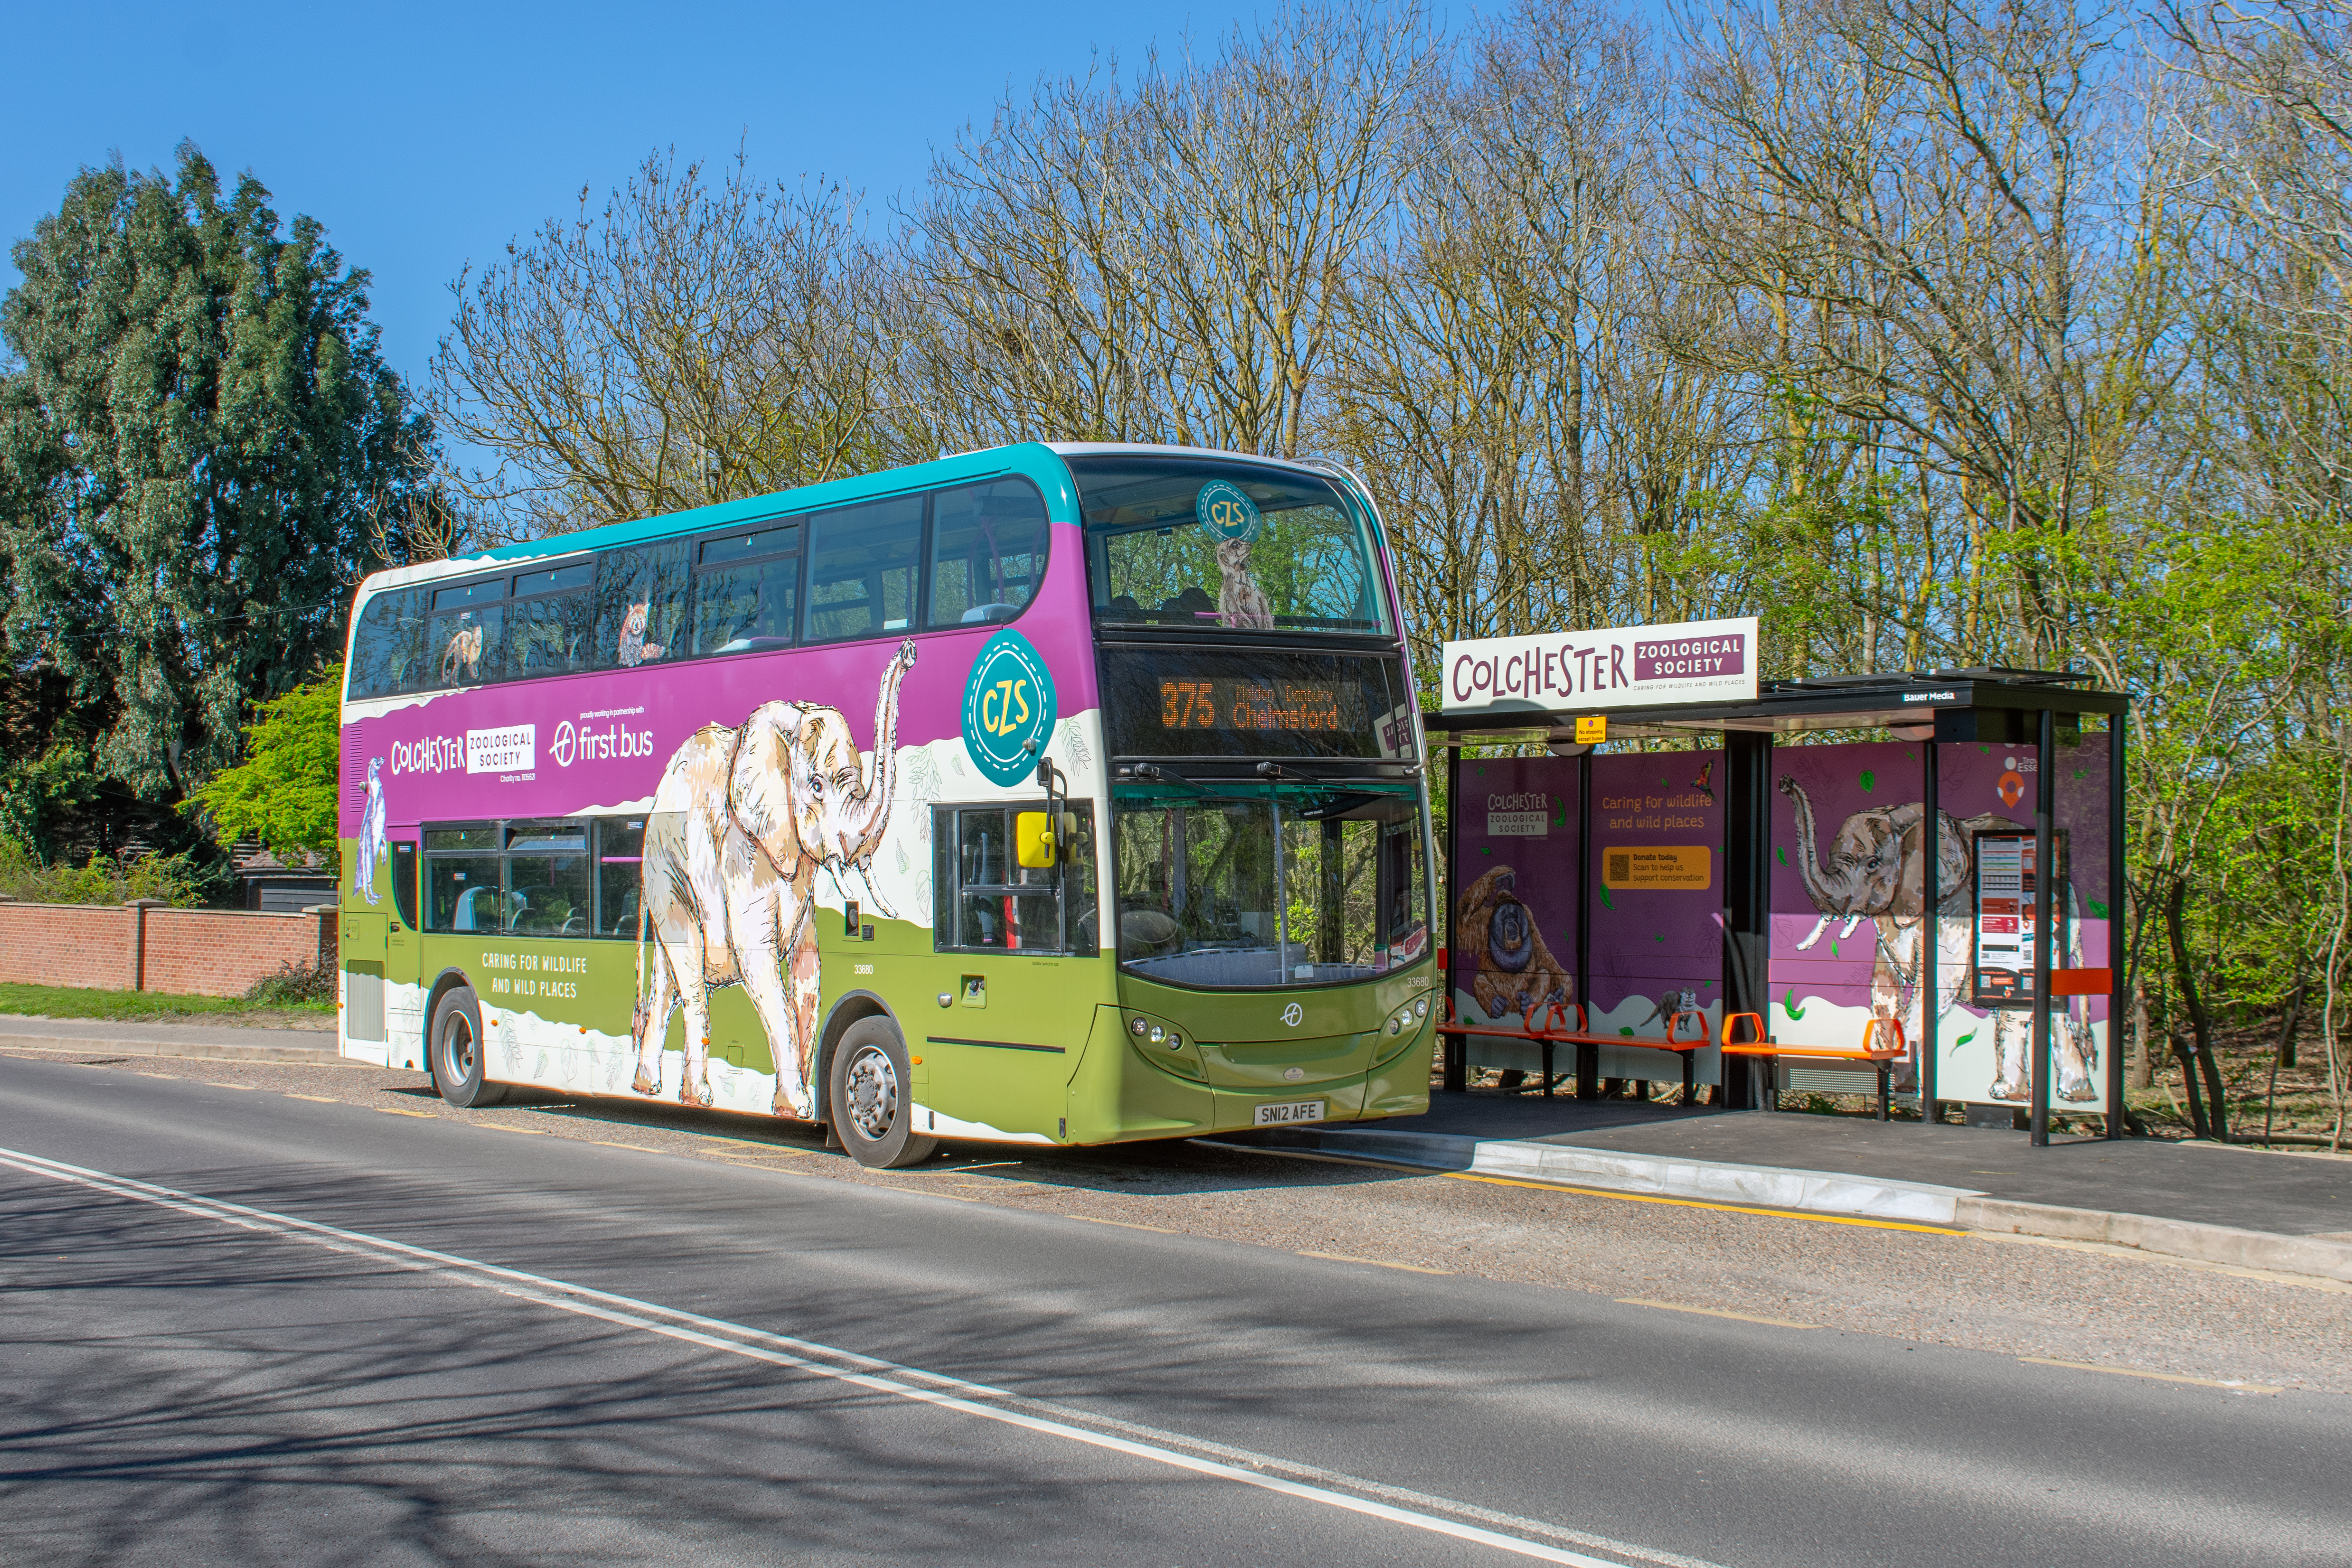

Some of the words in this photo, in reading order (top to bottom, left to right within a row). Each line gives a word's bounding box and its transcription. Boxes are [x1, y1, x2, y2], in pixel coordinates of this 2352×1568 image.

[1211, 501, 1244, 527] CZS
[1638, 639, 1740, 659] ZOOLOGICAL
[1453, 644, 1628, 702] COLCHESTER
[1654, 657, 1723, 675] SOCIETY
[1161, 682, 1214, 727] 375
[1929, 691, 1955, 700] Media
[580, 711, 594, 720] proudly
[594, 709, 609, 718] working
[613, 706, 636, 717] partnership
[983, 680, 1029, 737] CZS
[1234, 703, 1337, 729] Chelmsford
[470, 732, 531, 750] ZOOLOGICAL
[579, 724, 617, 760] first
[620, 723, 653, 757] bus
[391, 735, 465, 775] COLCHESTER
[480, 751, 521, 766] SOCIETY
[500, 775, 514, 784] Charity
[1488, 792, 1548, 810] COLCHESTER
[1603, 797, 1642, 812] Caring
[1646, 796, 1663, 808] for
[1667, 794, 1712, 807] wildlife
[1610, 816, 1633, 828] and
[1637, 816, 1661, 828] wild
[1665, 815, 1704, 831] places
[1658, 854, 1677, 863] today
[1660, 864, 1674, 872] help
[1634, 874, 1658, 883] support
[482, 953, 516, 969] CARING
[520, 955, 538, 970] FOR
[542, 955, 587, 973] WILDLIFE
[854, 964, 873, 974] 33680
[492, 977, 510, 993] AND
[514, 979, 535, 995] WILD
[540, 981, 577, 998] PLACES
[1407, 976, 1429, 987] 33680
[1262, 1106, 1288, 1122] SN12
[1292, 1104, 1315, 1120] AFE
